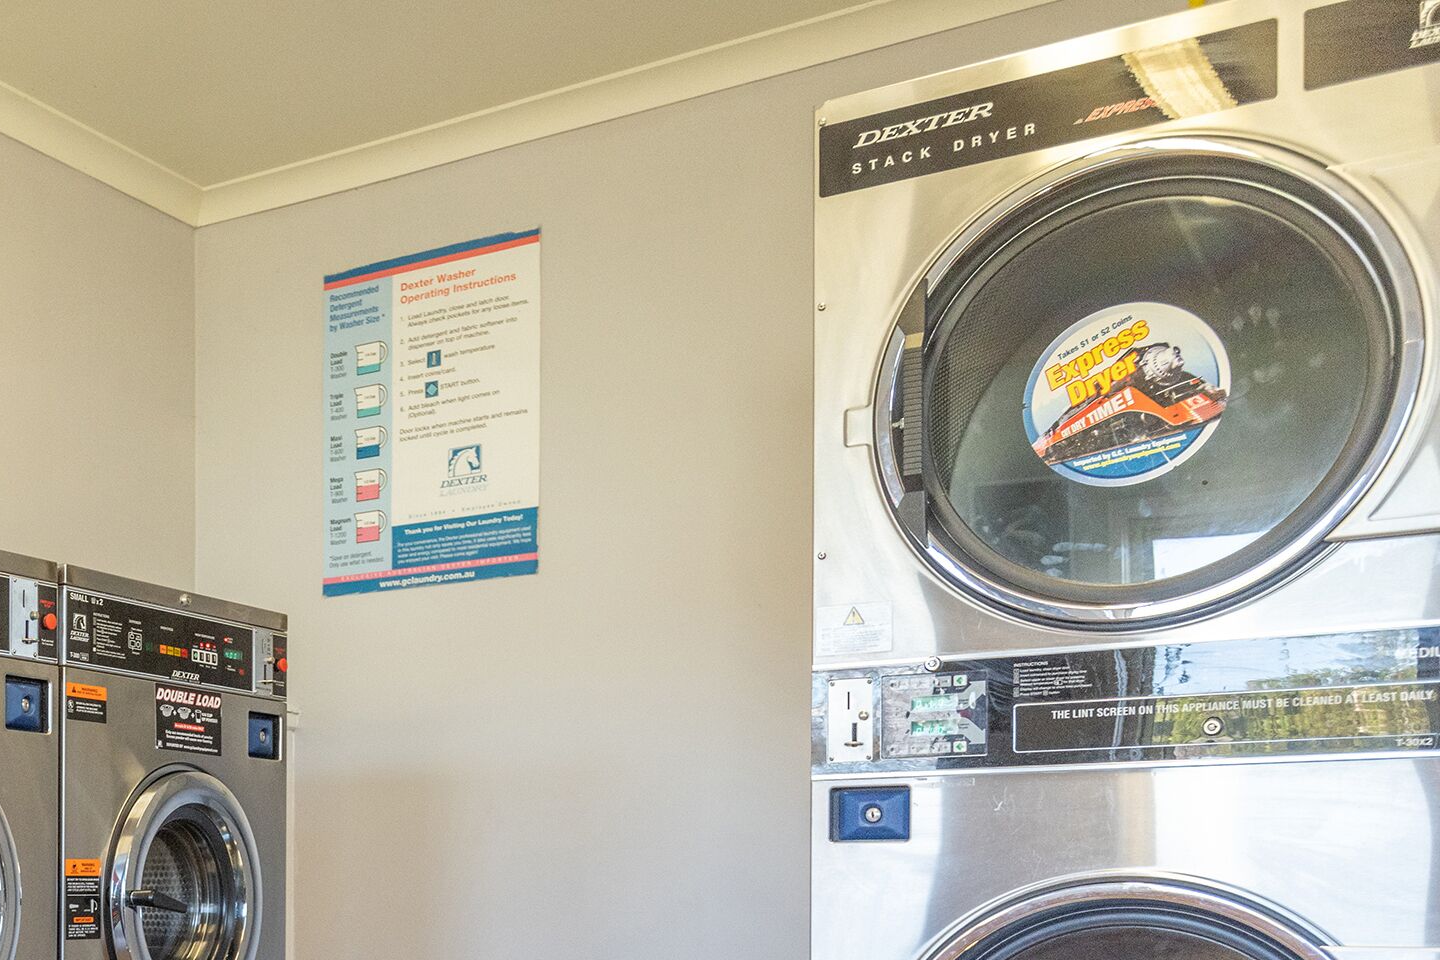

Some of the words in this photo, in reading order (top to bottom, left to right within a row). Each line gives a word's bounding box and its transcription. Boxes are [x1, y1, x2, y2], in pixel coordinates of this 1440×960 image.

[852, 102, 994, 149] DEXTER
[852, 146, 931, 175] STACK
[953, 122, 1035, 152] DRYER
[400, 278, 434, 292] Dexter
[436, 269, 476, 283] Washer
[400, 287, 450, 305] Operating
[453, 273, 517, 293] Instructions
[330, 286, 379, 302] Recommended
[330, 299, 362, 312] Detergent
[330, 306, 379, 322] Measurements
[339, 319, 364, 330] Washer
[366, 316, 380, 325] Size
[1058, 346, 1080, 361] Takes
[1092, 333, 1100, 342] or
[1112, 314, 1133, 330] Coins
[1044, 319, 1150, 391] Express
[1066, 352, 1139, 407] Dryer
[1070, 416, 1087, 434] DRY
[1087, 388, 1135, 424] TIME!
[440, 474, 488, 489] DEXTER
[404, 527, 422, 535] Thank
[444, 522, 465, 530] Visiting
[478, 517, 502, 526] Laundry
[379, 570, 476, 588] www.gclaundry.com.au
[70, 592, 89, 603] SMALL
[172, 670, 200, 681] DEXTER
[156, 688, 196, 705] DOUBLE
[196, 694, 221, 709] LOAD
[1051, 710, 1071, 720] THE
[1072, 708, 1095, 718] LINT
[1096, 706, 1136, 718] SCREEN
[1138, 705, 1154, 715] ON
[1155, 704, 1180, 714] THIS
[1182, 700, 1239, 712] APPLIANCE
[1242, 698, 1274, 709] MUST
[1276, 698, 1289, 708] BE
[1293, 694, 1342, 707] CLEANED
[1345, 693, 1361, 704] AT
[1362, 692, 1398, 703] LEAST
[1400, 690, 1435, 701] DAILY
